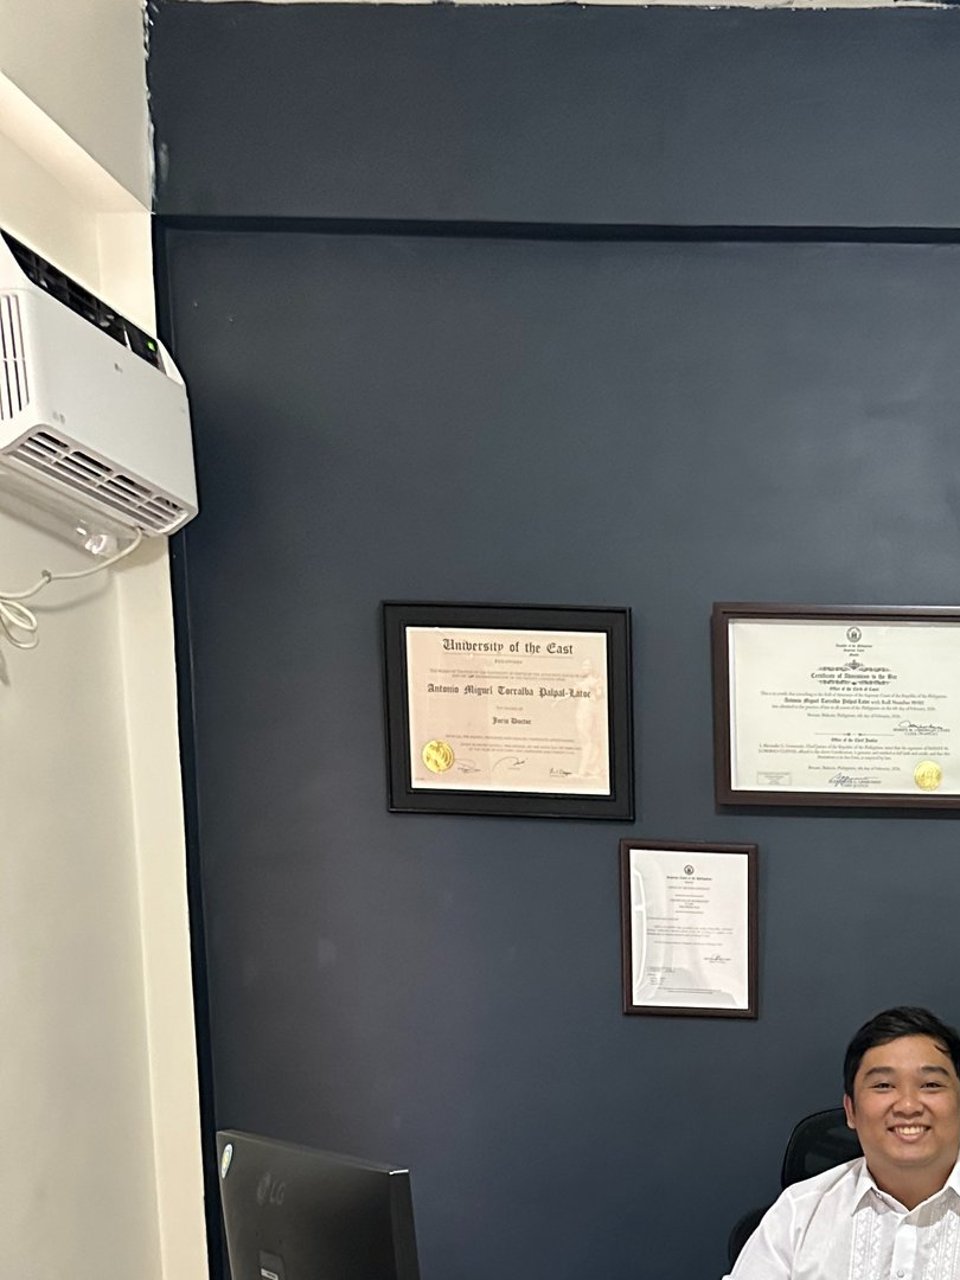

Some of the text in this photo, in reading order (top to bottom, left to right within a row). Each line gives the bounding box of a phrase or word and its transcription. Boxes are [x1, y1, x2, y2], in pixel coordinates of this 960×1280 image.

[443, 638, 573, 654] University of the East
[427, 683, 459, 694] Antonio
[464, 684, 493, 696] Miguel
[497, 685, 534, 696] Torralba
